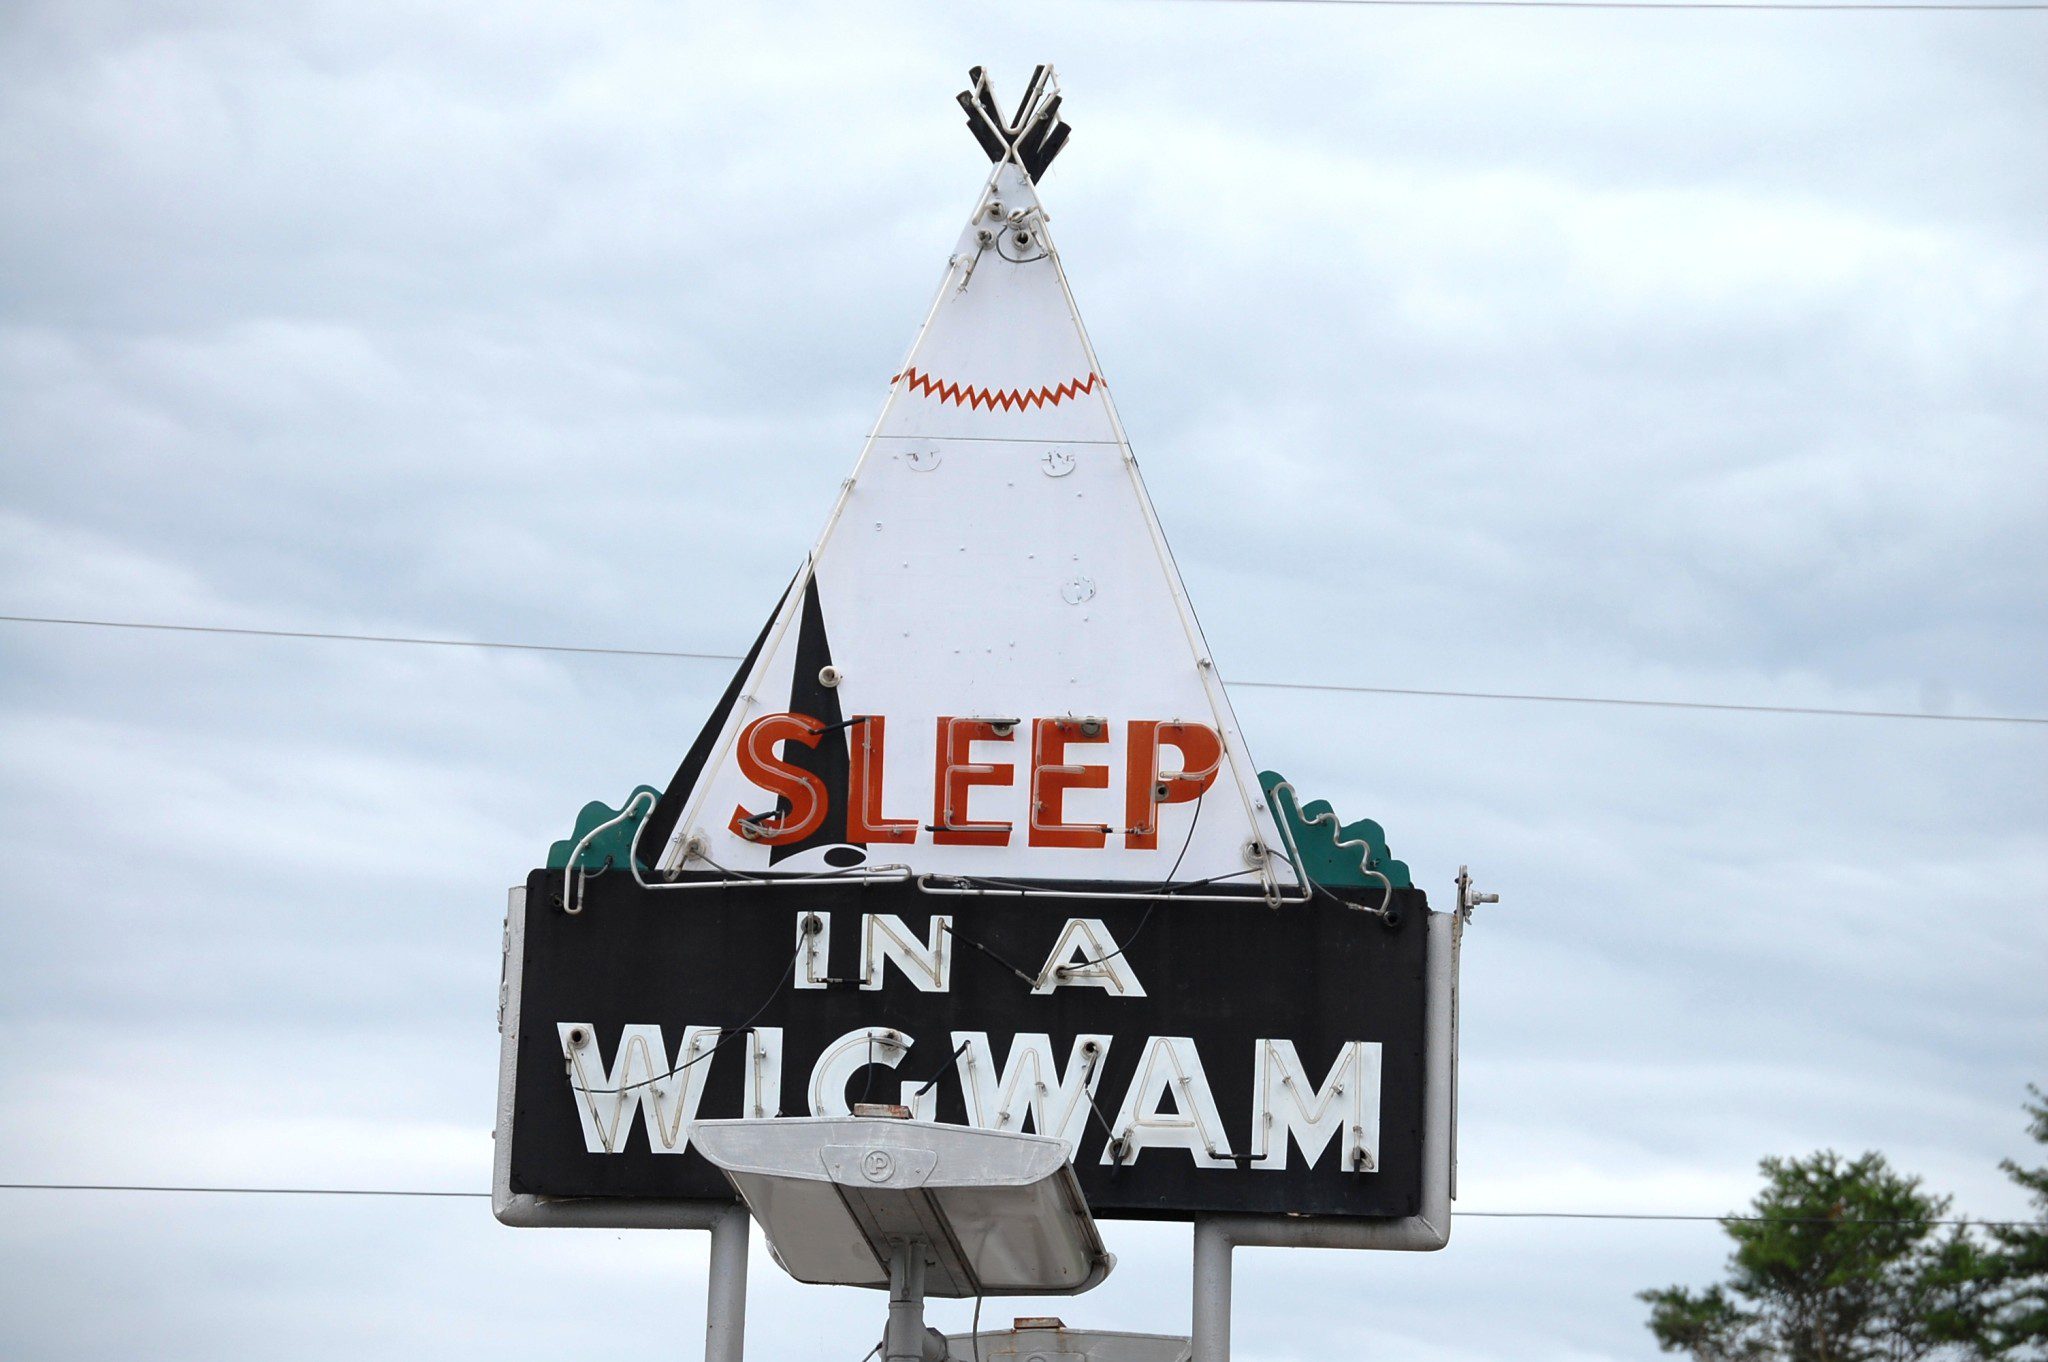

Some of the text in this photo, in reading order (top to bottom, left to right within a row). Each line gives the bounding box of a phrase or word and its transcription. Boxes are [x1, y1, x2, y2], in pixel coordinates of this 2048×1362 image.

[728, 712, 1223, 850] SLEEP
[794, 911, 1148, 998] IN A
[556, 1021, 1383, 1173] WIGWAM
